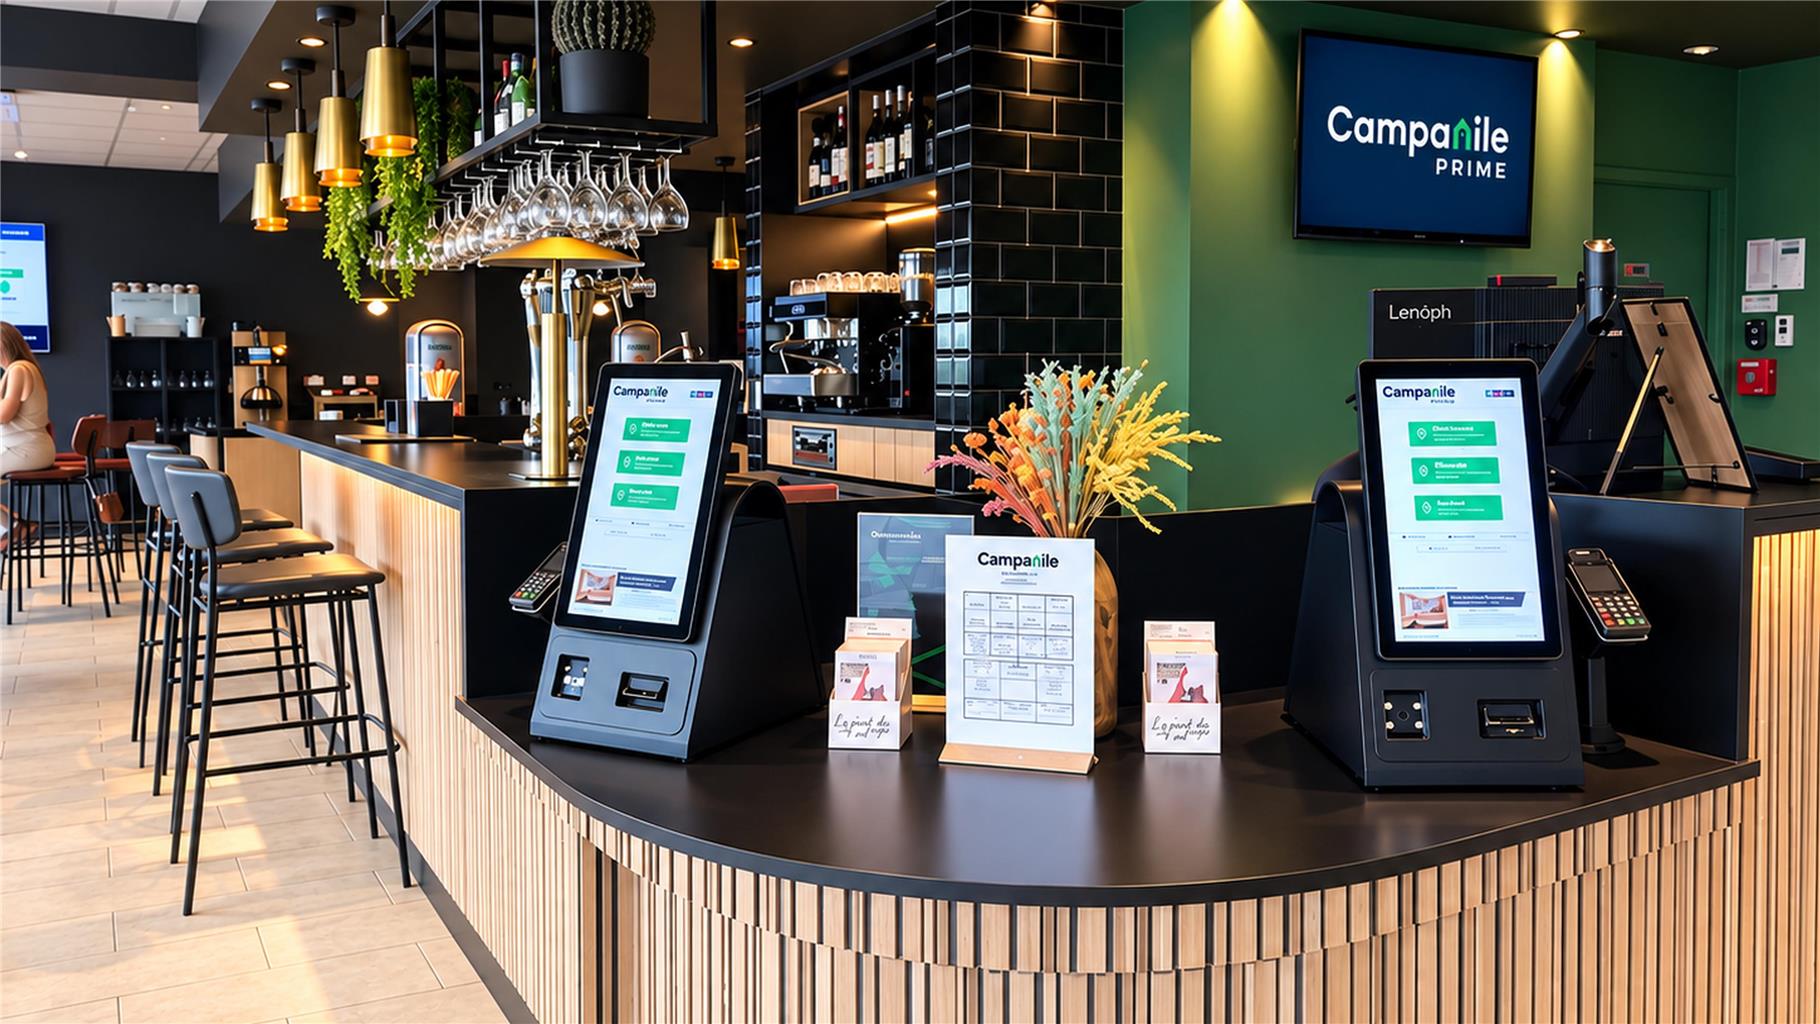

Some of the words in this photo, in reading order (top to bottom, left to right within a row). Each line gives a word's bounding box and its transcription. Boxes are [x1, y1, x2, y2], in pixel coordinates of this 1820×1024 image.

[1327, 105, 1509, 158] Campanile
[1435, 158, 1507, 179] PRIME
[1382, 385, 1456, 401] Campanile
[977, 552, 1059, 571] Campanile
